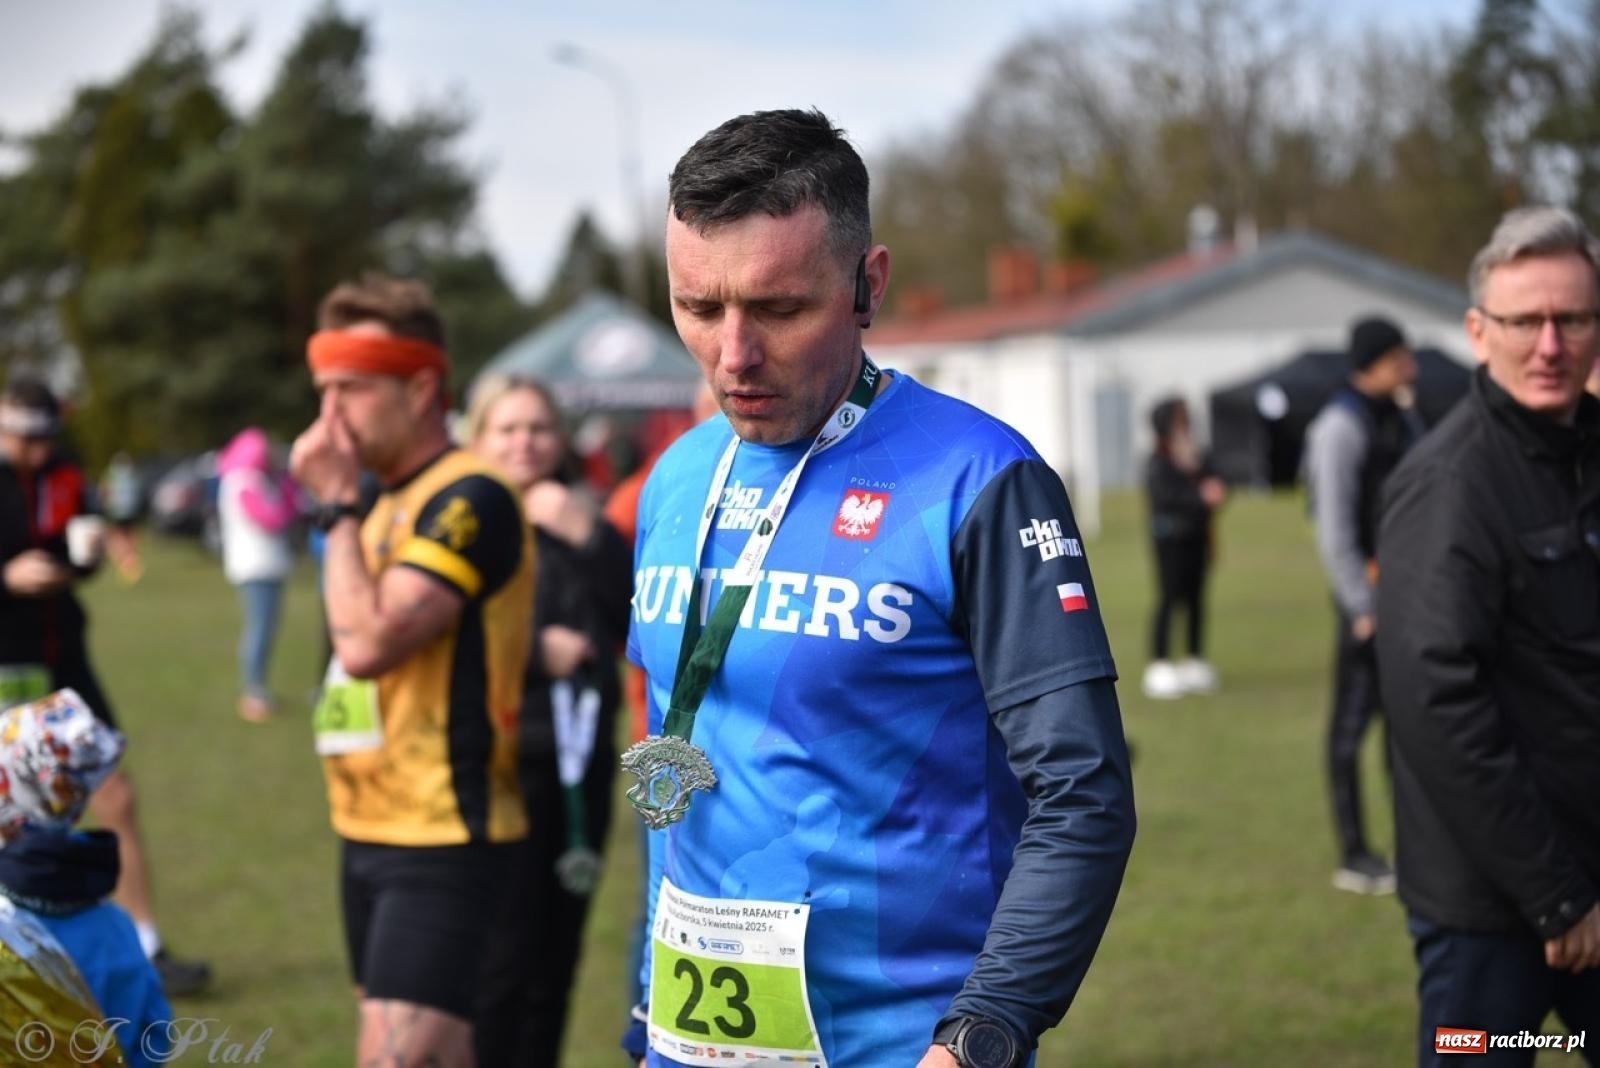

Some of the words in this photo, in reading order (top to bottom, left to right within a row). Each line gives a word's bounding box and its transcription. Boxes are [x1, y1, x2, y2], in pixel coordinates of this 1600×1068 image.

[850, 476, 896, 490] POLAND
[715, 905, 741, 918] Leśny
[742, 907, 789, 920] RAFAMET
[708, 919, 744, 930] kwietnia
[745, 921, 767, 932] 2025
[674, 957, 756, 1039] 23
